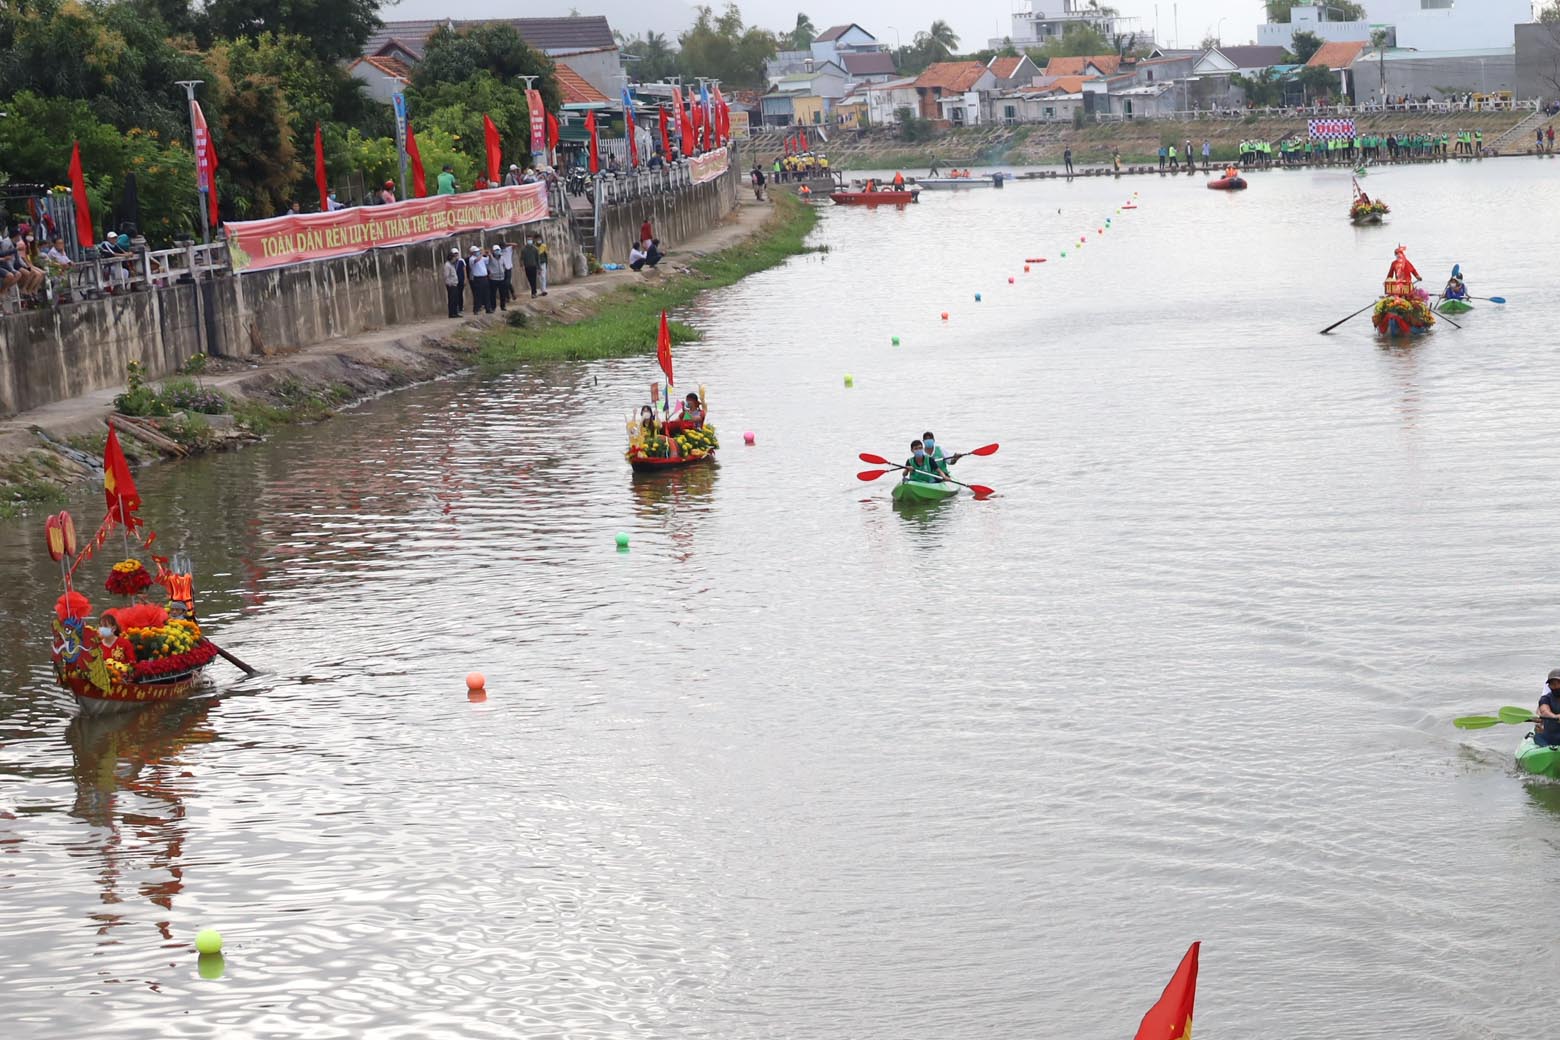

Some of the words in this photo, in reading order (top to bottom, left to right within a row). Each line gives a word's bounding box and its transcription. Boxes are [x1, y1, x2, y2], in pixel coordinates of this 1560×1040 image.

[261, 231, 294, 258] TOÀN
[297, 226, 323, 252] DÂN
[326, 224, 348, 248] RÈN
